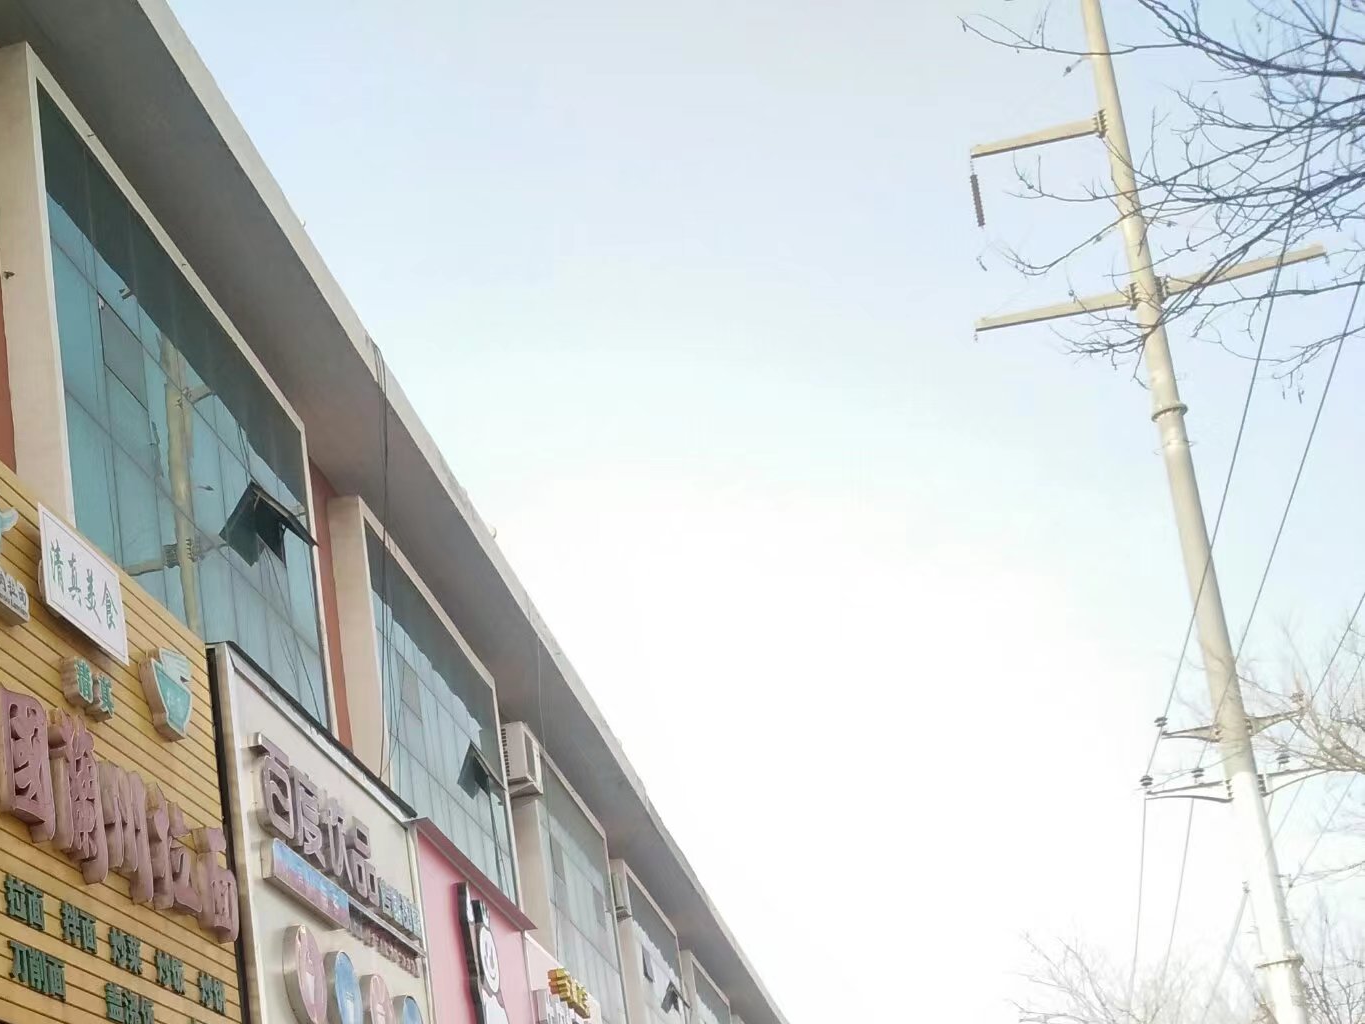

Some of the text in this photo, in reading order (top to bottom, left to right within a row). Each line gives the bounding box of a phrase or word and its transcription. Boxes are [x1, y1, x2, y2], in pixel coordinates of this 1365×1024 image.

[50, 537, 119, 631] 清真美食
[72, 656, 115, 716] 清真
[248, 733, 380, 904] 百度优品
[5, 872, 45, 933] 拉面
[7, 939, 66, 1001] 刀削面
